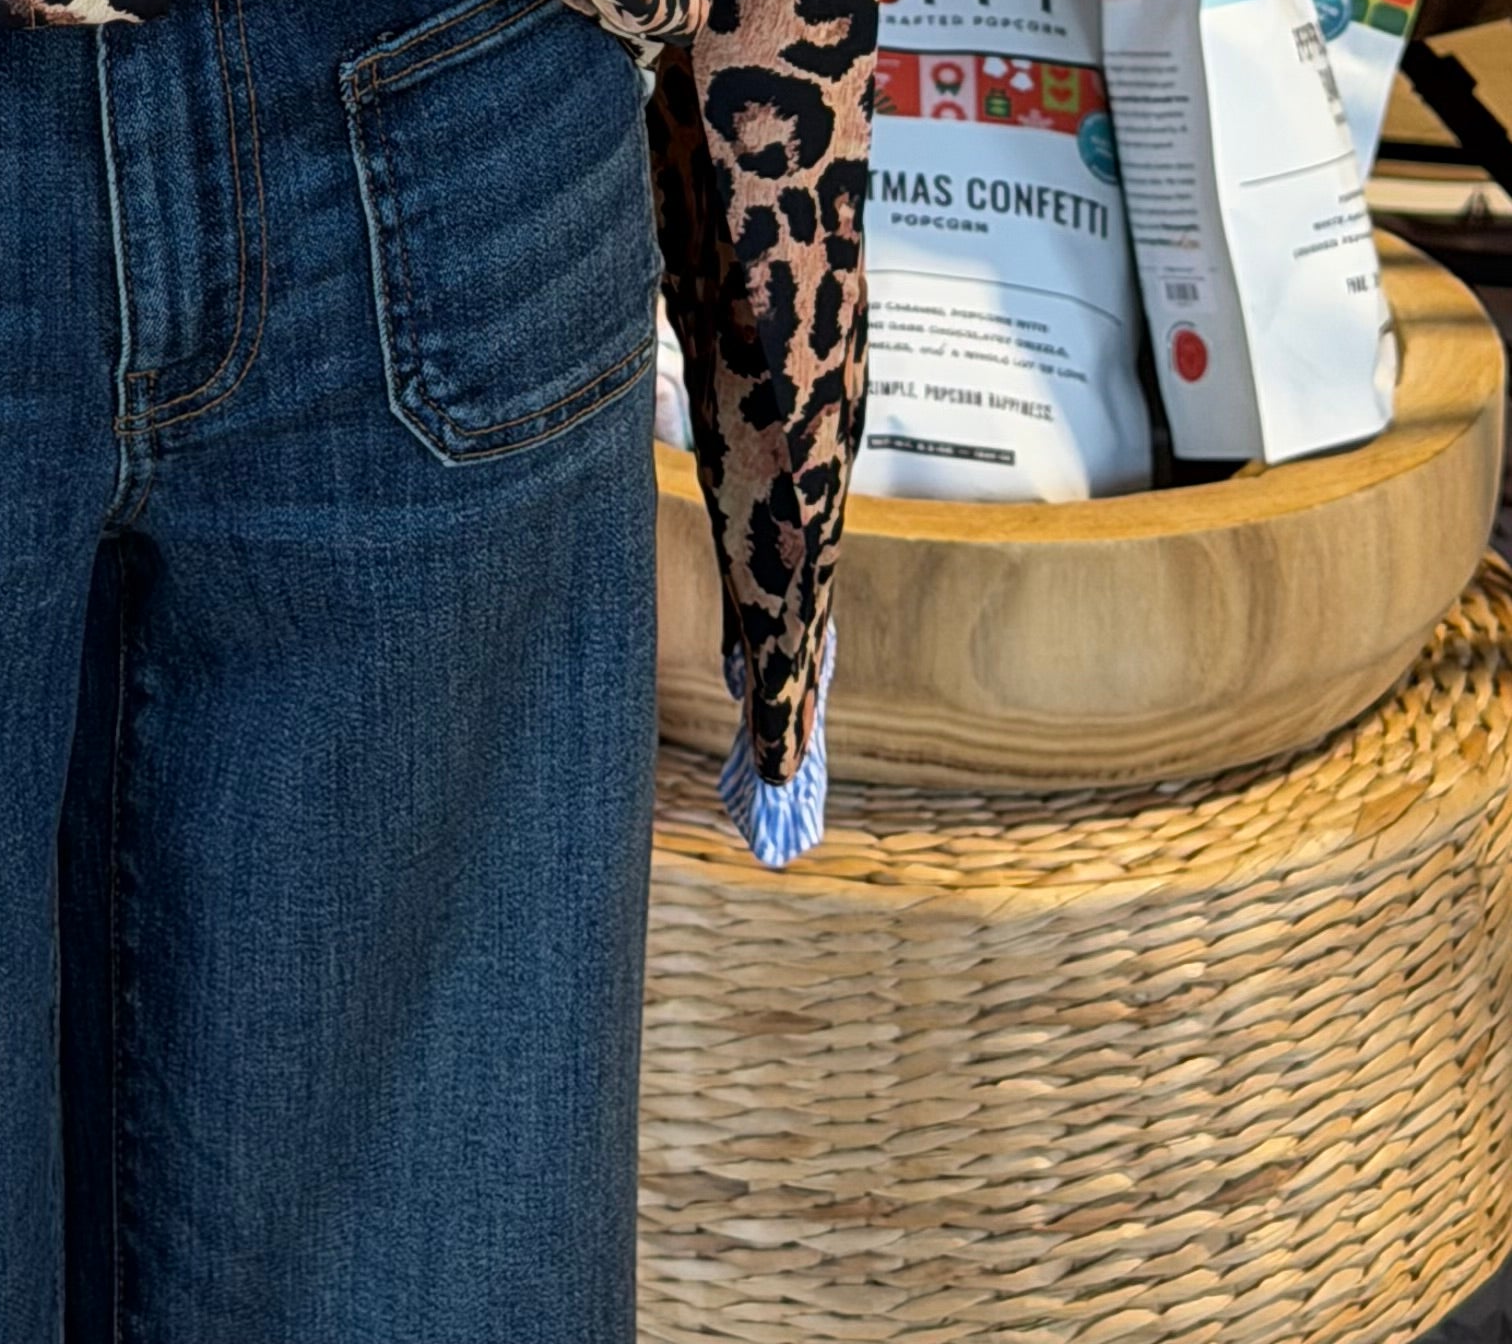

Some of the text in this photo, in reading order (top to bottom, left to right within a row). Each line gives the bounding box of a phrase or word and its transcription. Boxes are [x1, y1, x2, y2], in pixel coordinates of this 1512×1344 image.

[879, 14, 1068, 37] RAFTED POPCORN
[865, 169, 953, 207] TMAS
[966, 176, 1109, 239] CONFETTI
[891, 212, 990, 234] POPCORN
